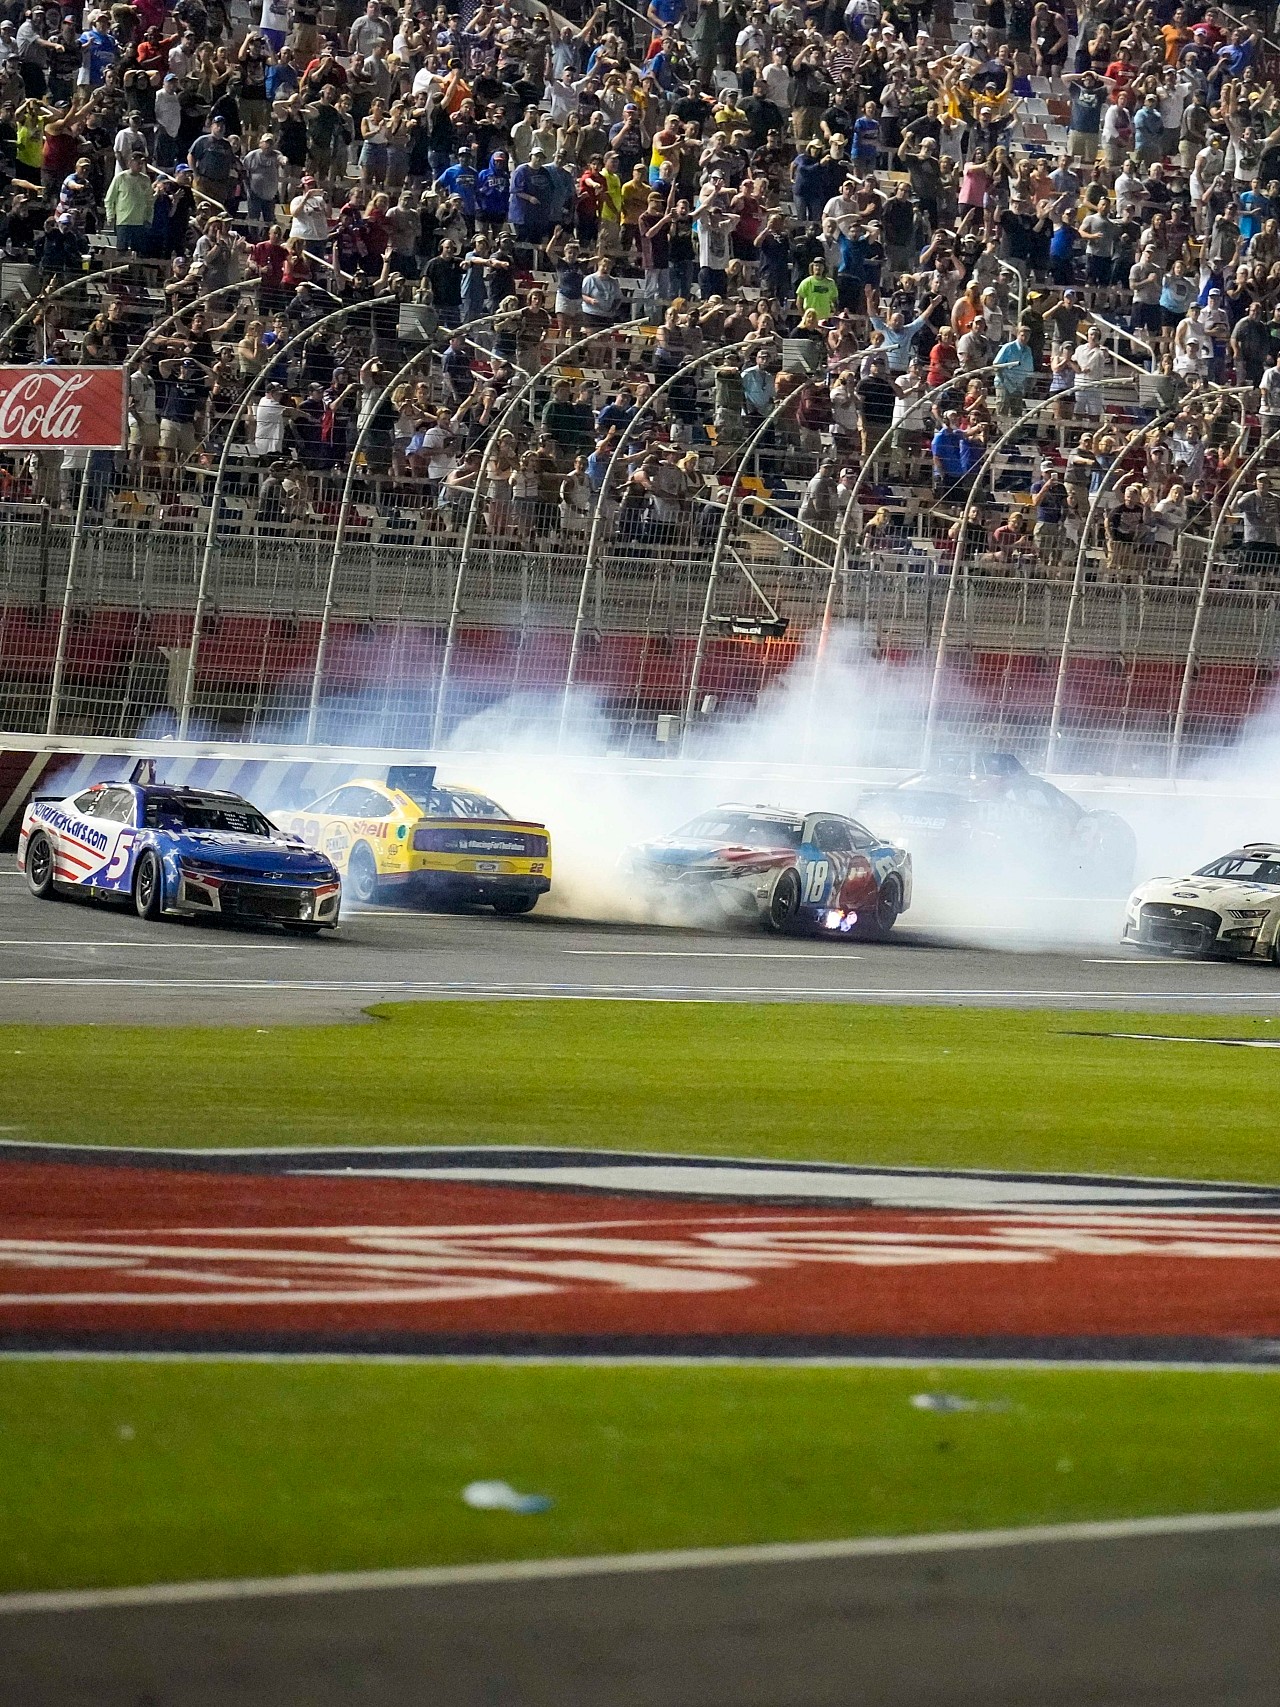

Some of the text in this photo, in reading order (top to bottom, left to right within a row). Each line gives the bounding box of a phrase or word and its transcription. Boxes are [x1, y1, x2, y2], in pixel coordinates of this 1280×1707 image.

[353, 820, 389, 839] Shell
[902, 816, 946, 829] TRACKER
[105, 829, 136, 881] 5
[529, 863, 545, 874] 22
[805, 860, 829, 903] 18
